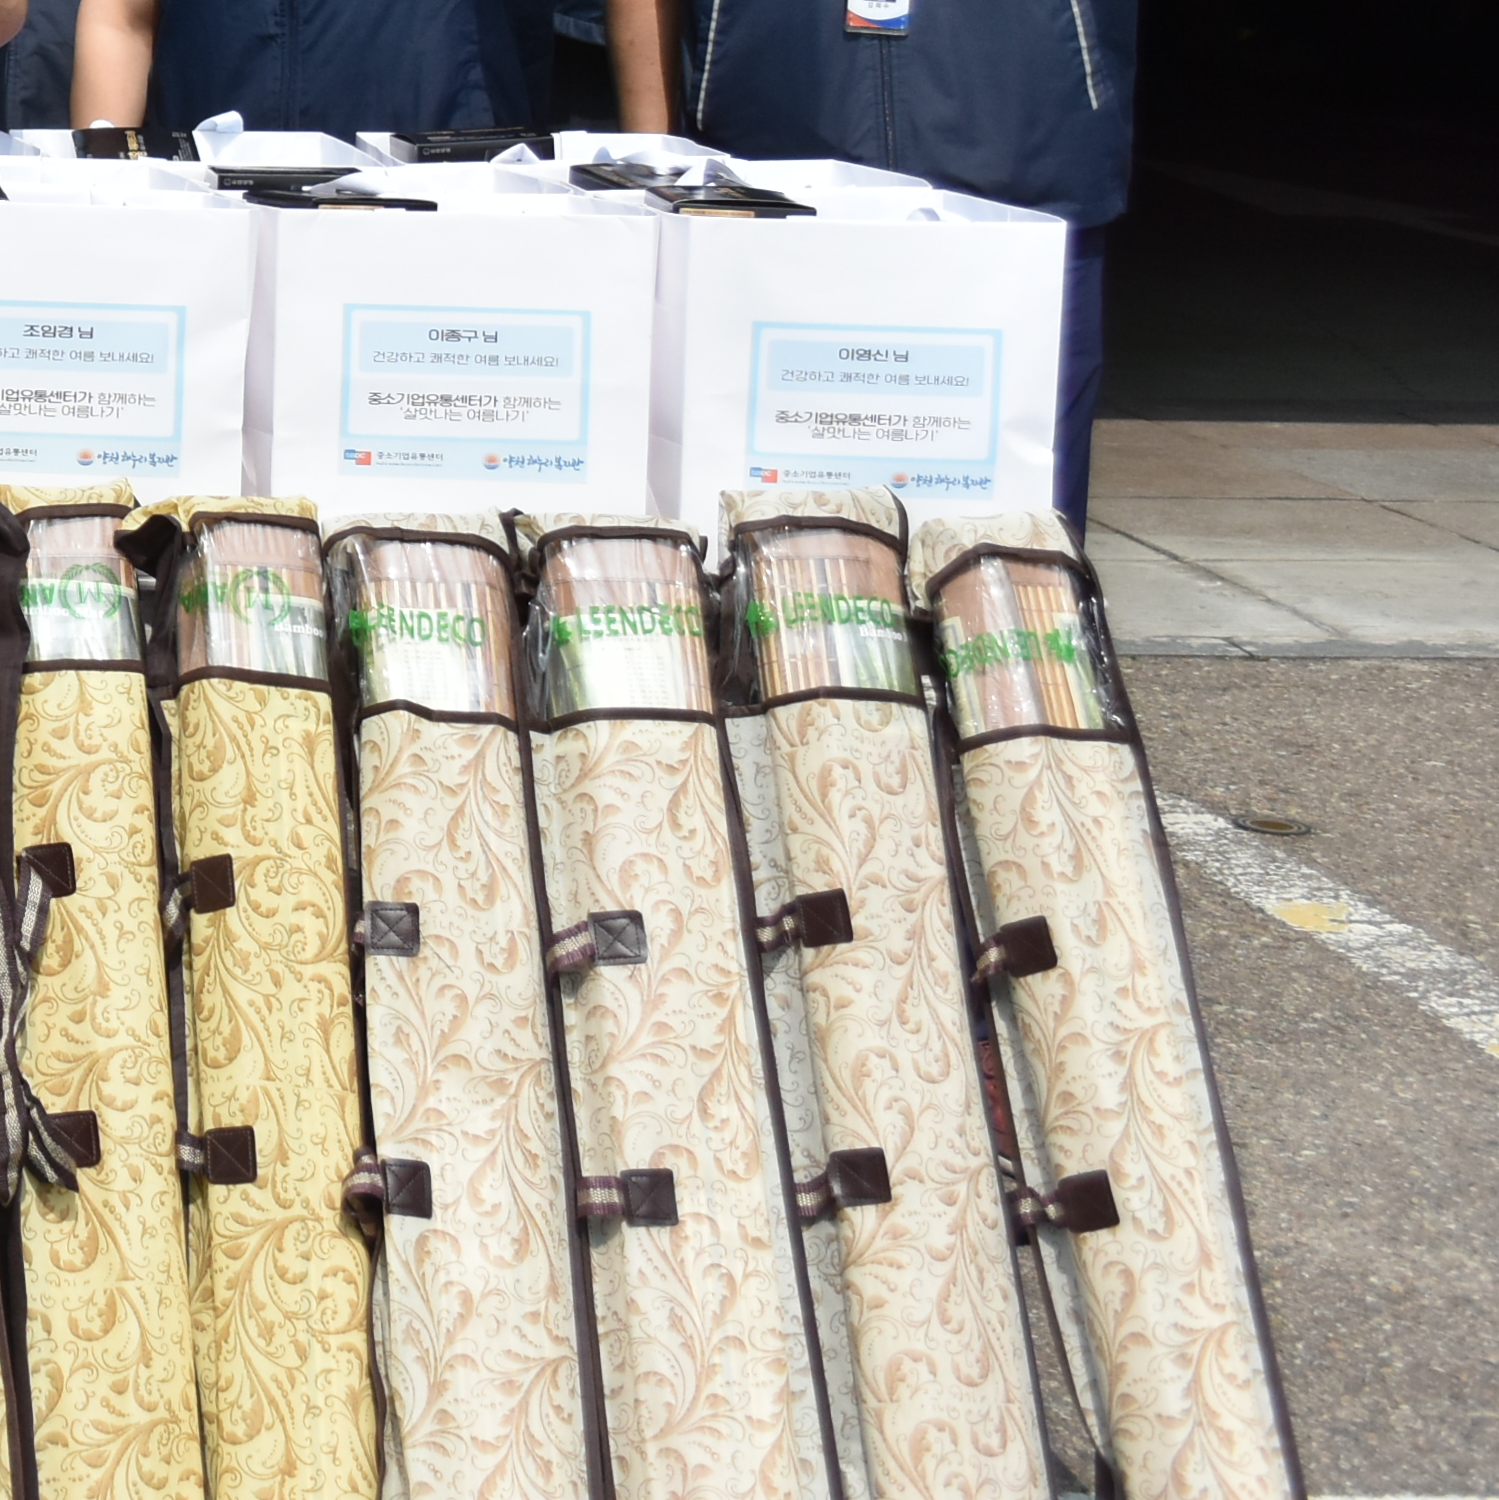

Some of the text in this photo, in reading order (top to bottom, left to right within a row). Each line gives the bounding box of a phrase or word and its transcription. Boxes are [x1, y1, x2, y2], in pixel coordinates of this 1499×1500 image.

[78, 326, 94, 339] 님
[482, 331, 498, 343] 님
[24, 348, 65, 361] 쾌적한
[69, 350, 94, 362] 여름
[99, 351, 154, 364] 보내세요!
[373, 351, 558, 367] 건강하고 쾌적한 여름 보내세요!
[893, 350, 909, 363] 님
[781, 370, 969, 387] 건강하고 쾌적한 여름 보내세요!
[97, 392, 155, 406] 함께하는
[368, 393, 561, 410] 중소기업유통센터가 함께하는
[775, 411, 971, 429] 중소기업유통센터가 함께하는
